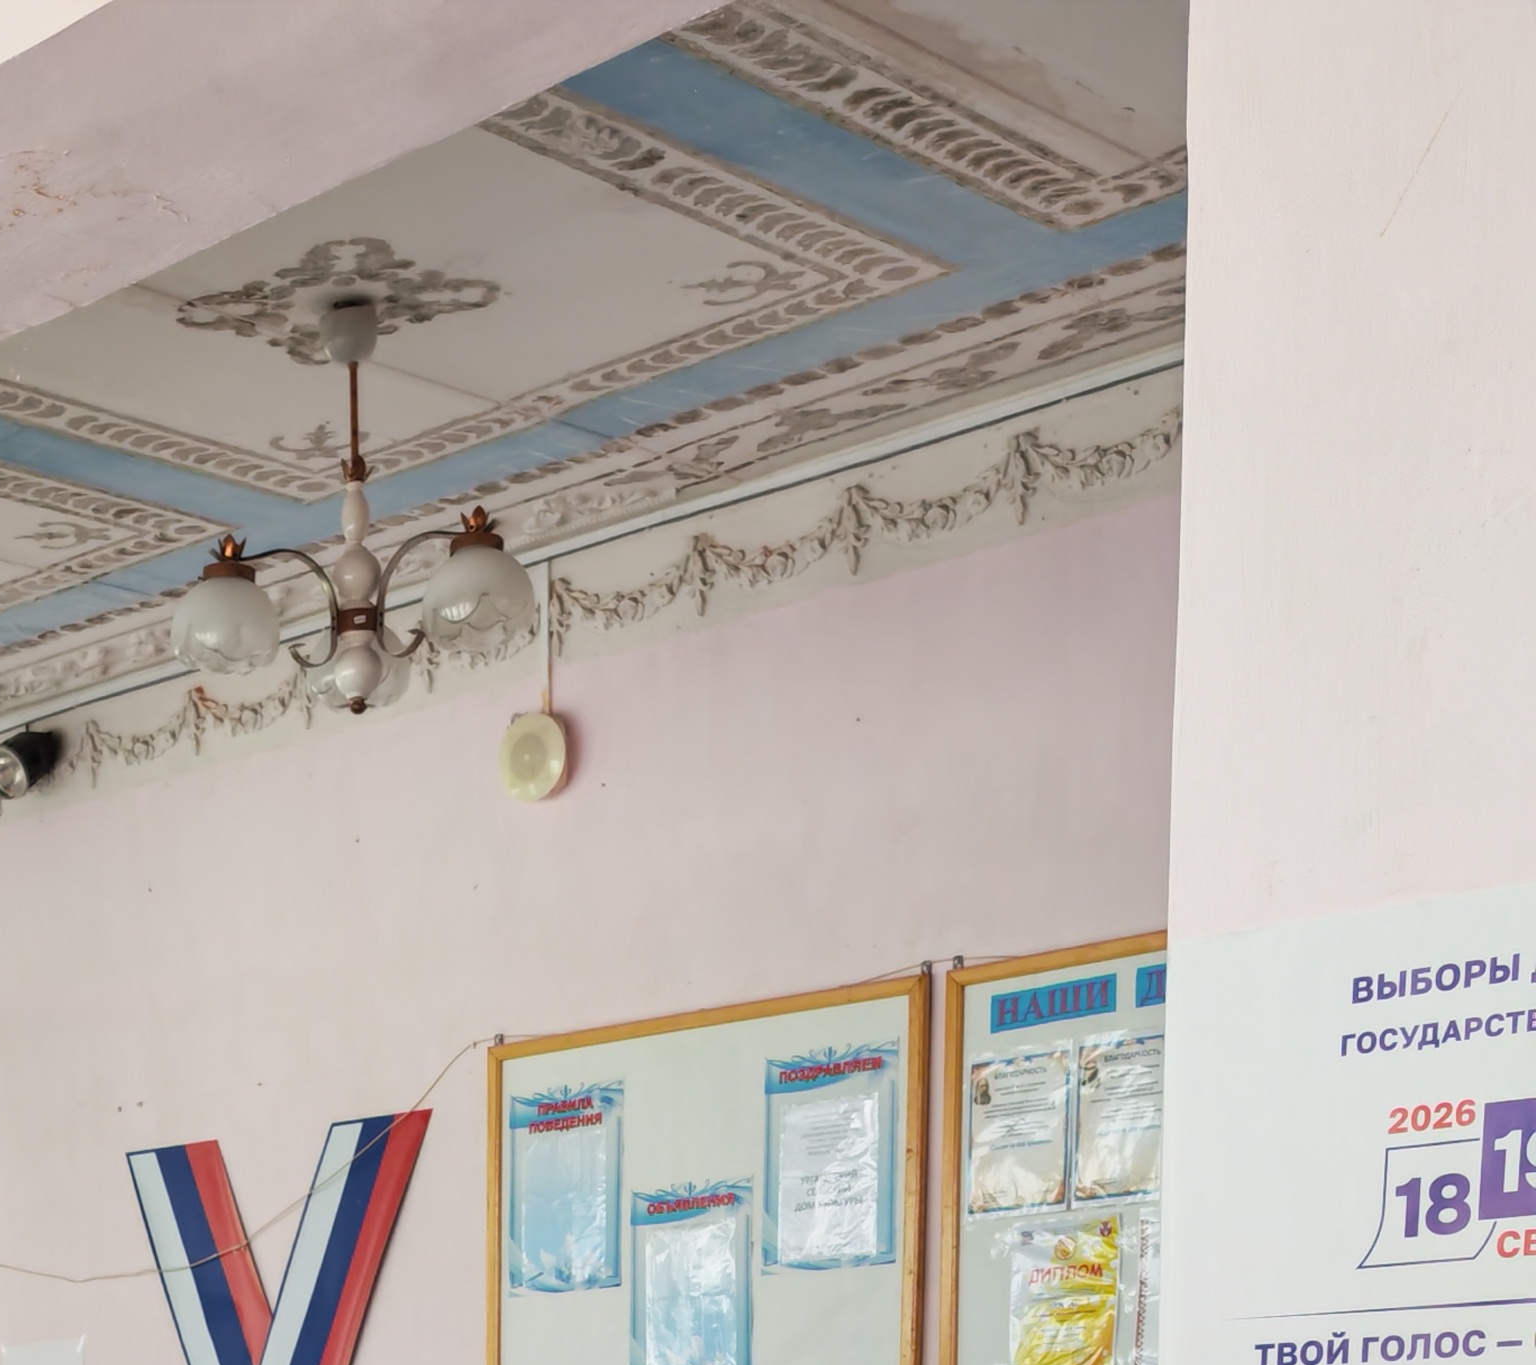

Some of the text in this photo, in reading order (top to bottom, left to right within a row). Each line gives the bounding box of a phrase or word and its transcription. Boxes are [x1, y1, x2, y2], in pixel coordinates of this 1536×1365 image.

[1352, 953, 1520, 1004] ВЫБОРЫ
[996, 978, 1111, 1027] НАШИ
[528, 1112, 602, 1134] ПОВЕДЕНИЯ
[1388, 1099, 1476, 1134] 2026
[1395, 1173, 1471, 1238] 18
[1029, 1264, 1104, 1285] ДИПЛОМ
[1361, 1330, 1486, 1363] ГОЛОС
